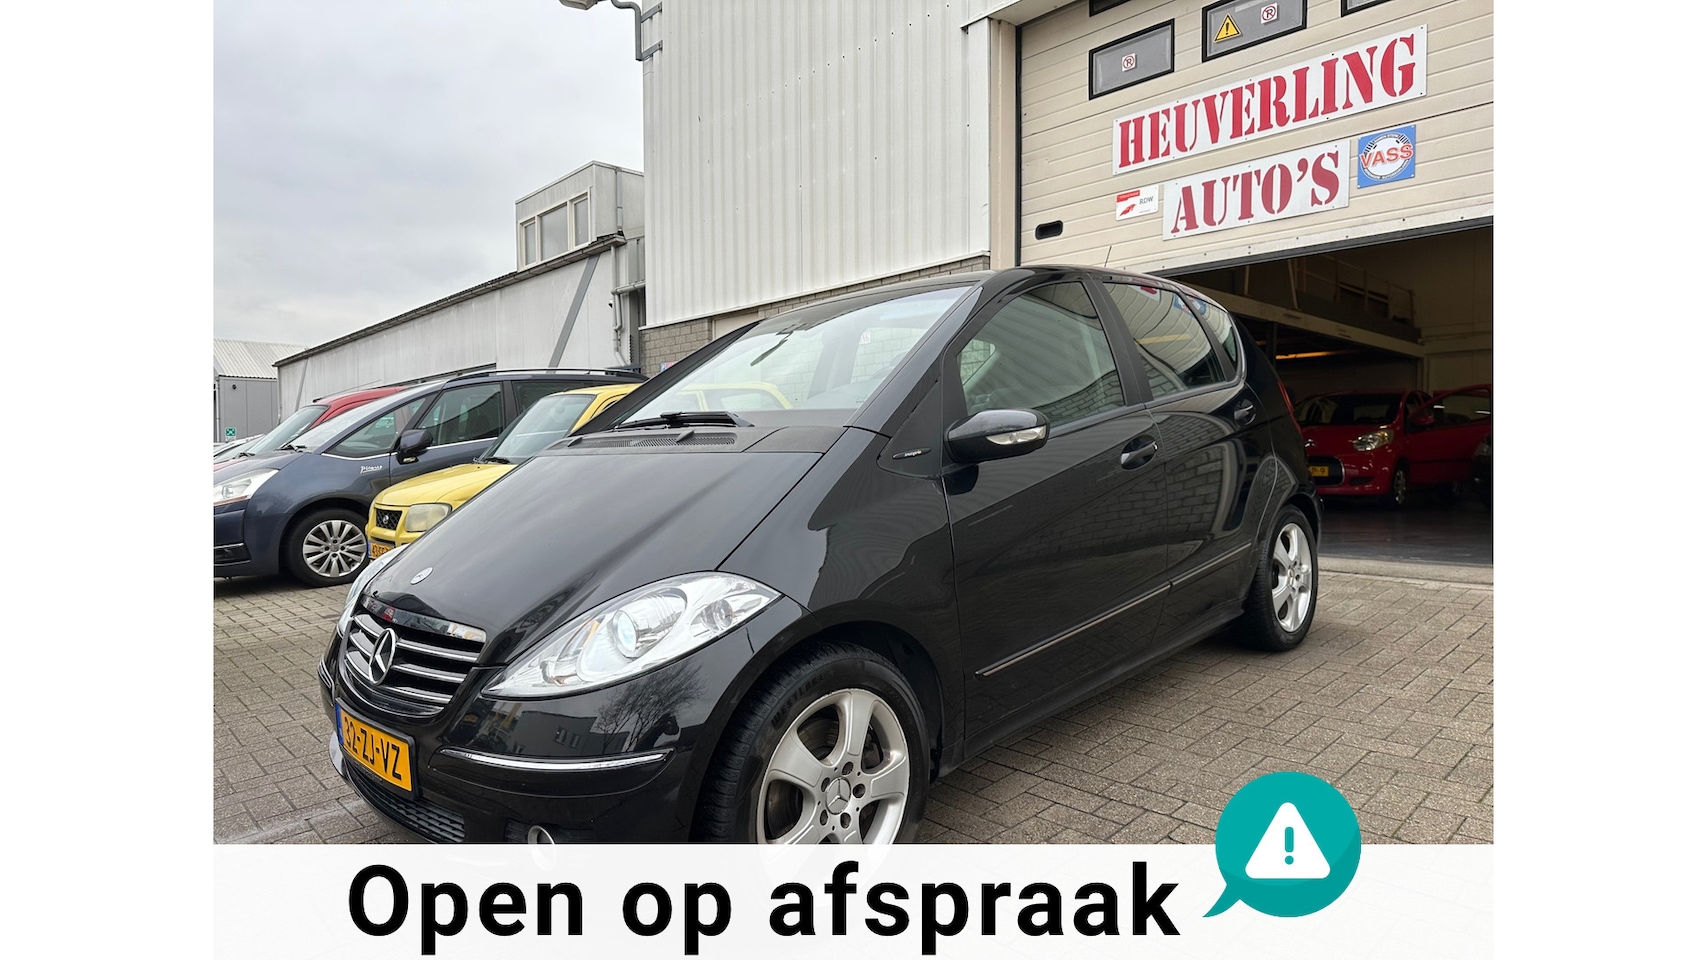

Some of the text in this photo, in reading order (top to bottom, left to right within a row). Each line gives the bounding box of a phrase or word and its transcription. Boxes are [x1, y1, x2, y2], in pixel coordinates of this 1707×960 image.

[1118, 33, 1416, 169] HEUVERLING
[1360, 144, 1413, 168] VASS
[1138, 195, 1155, 205] RDW
[1171, 151, 1340, 233] AUTO'S
[344, 716, 402, 781] 32-ZJ-VZ
